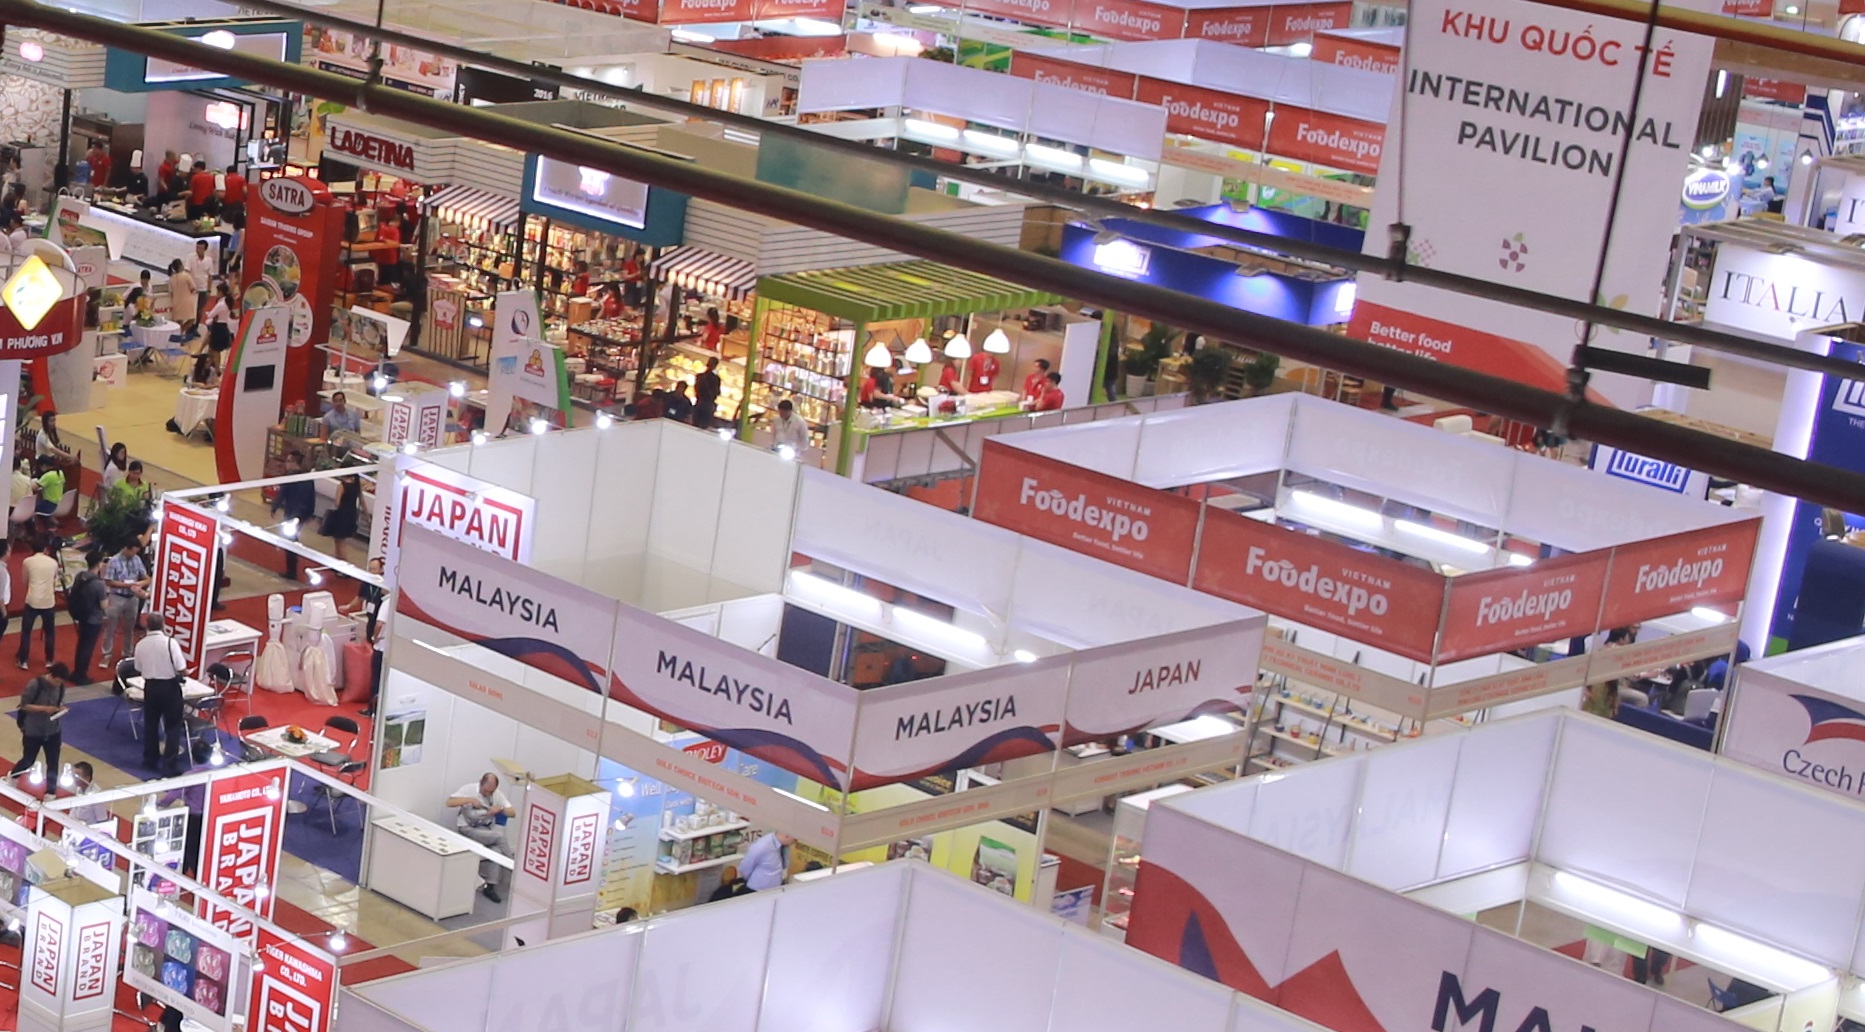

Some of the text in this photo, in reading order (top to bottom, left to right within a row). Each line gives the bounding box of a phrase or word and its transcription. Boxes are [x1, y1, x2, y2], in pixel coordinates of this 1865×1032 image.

[1440, 8, 1510, 45] KHU
[1519, 24, 1623, 67] QUỐC
[1408, 69, 1681, 150] INTERNATIONAL
[329, 126, 416, 172] LADETINA
[1457, 120, 1614, 178] PAVILION
[268, 183, 305, 209] SATRA
[1719, 269, 1848, 325] ITALIA
[6, 333, 49, 350] PHƯƠNG
[1369, 320, 1453, 355] Better food
[411, 488, 509, 549] JAPAN
[1019, 476, 1150, 544] Foodexpo
[1106, 495, 1153, 517] VIETNAM
[1696, 542, 1729, 557] VIETNAM
[173, 549, 200, 648] JAPAN
[1245, 545, 1389, 617] Foodexpo
[1341, 567, 1392, 590] VIETNAM
[1543, 574, 1576, 589] VIETNAM
[1635, 556, 1724, 595] Foodexpo
[437, 564, 561, 635] MALAYSIA
[1476, 587, 1573, 628] Foodexpo
[656, 650, 795, 726] MALAYSIA
[1127, 659, 1202, 696] JAPAN
[894, 695, 1017, 742] MALAYSIA
[1782, 749, 1853, 791] Czech
[43, 923, 59, 988] JAPAN
[78, 934, 92, 992] BRAND
[86, 929, 107, 991] JAPAN
[265, 942, 284, 966] TIGER
